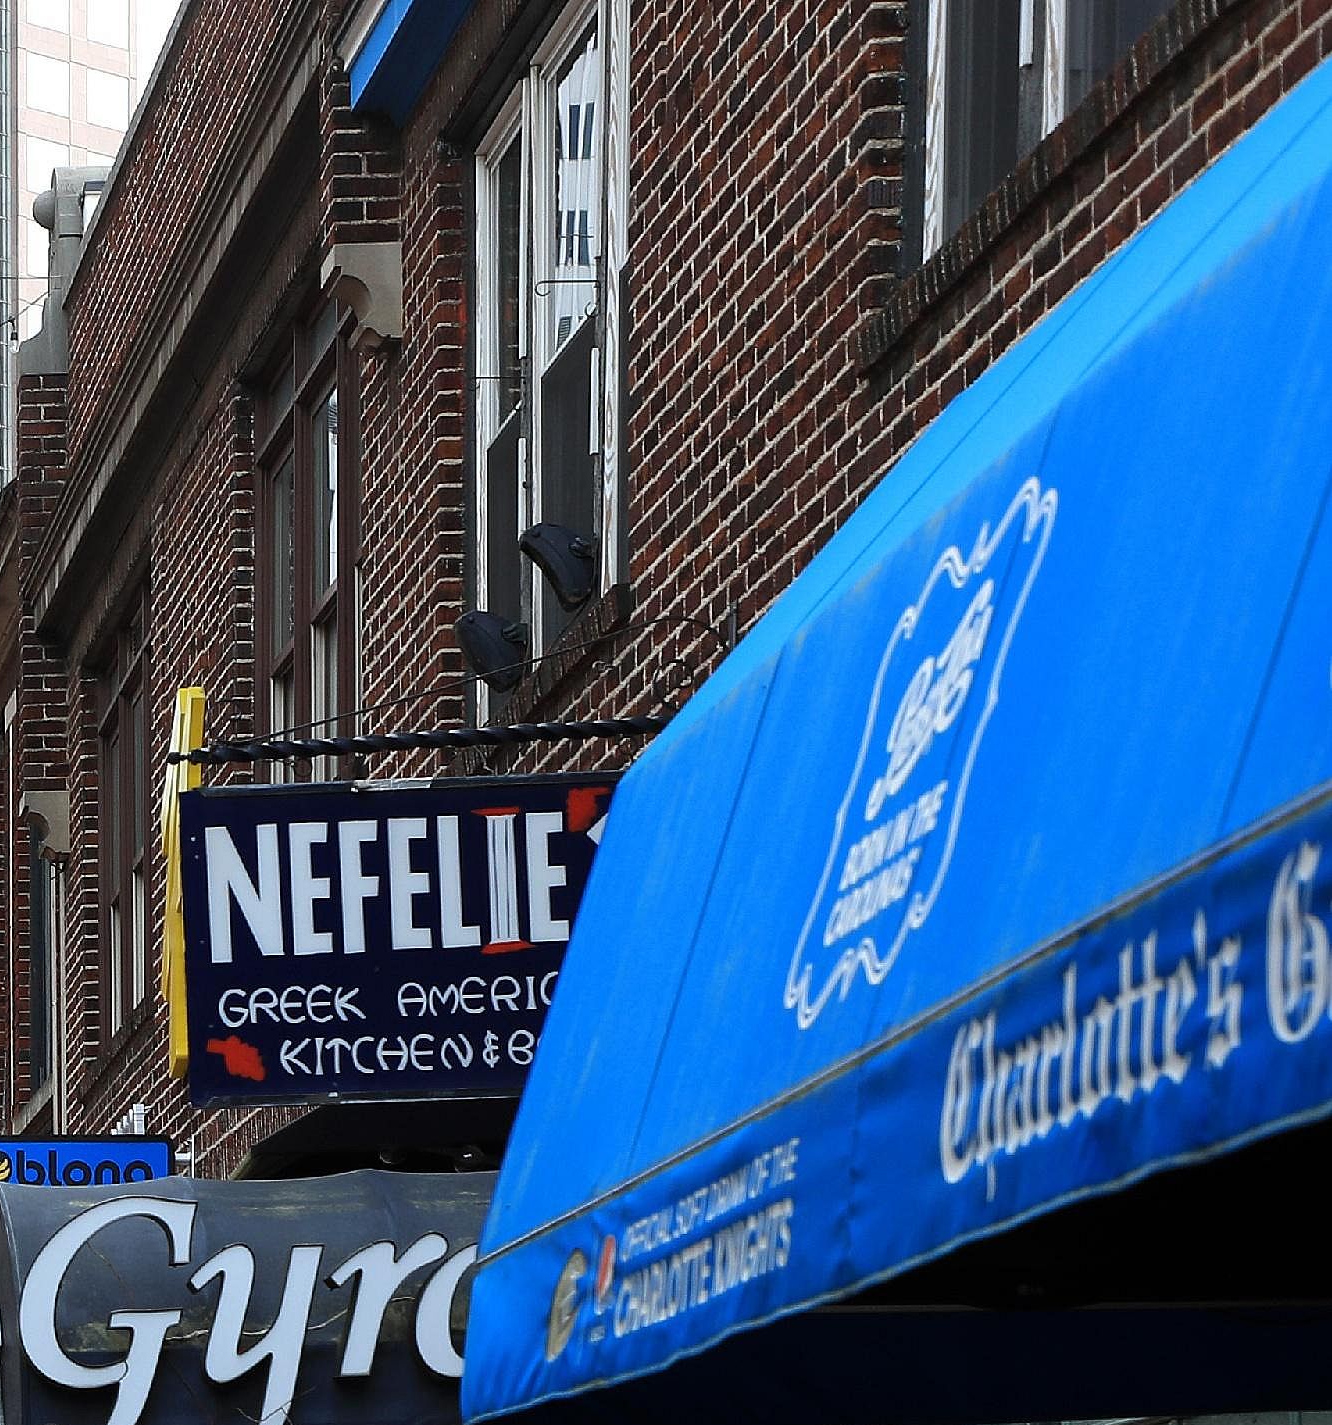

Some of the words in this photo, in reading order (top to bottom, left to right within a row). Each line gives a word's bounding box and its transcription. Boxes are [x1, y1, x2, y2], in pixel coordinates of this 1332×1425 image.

[204, 808, 605, 964] NEFELIE
[218, 986, 366, 1028] GREEK
[279, 1032, 473, 1076] KITCHEN
[940, 906, 1242, 1201] Charlotte's
